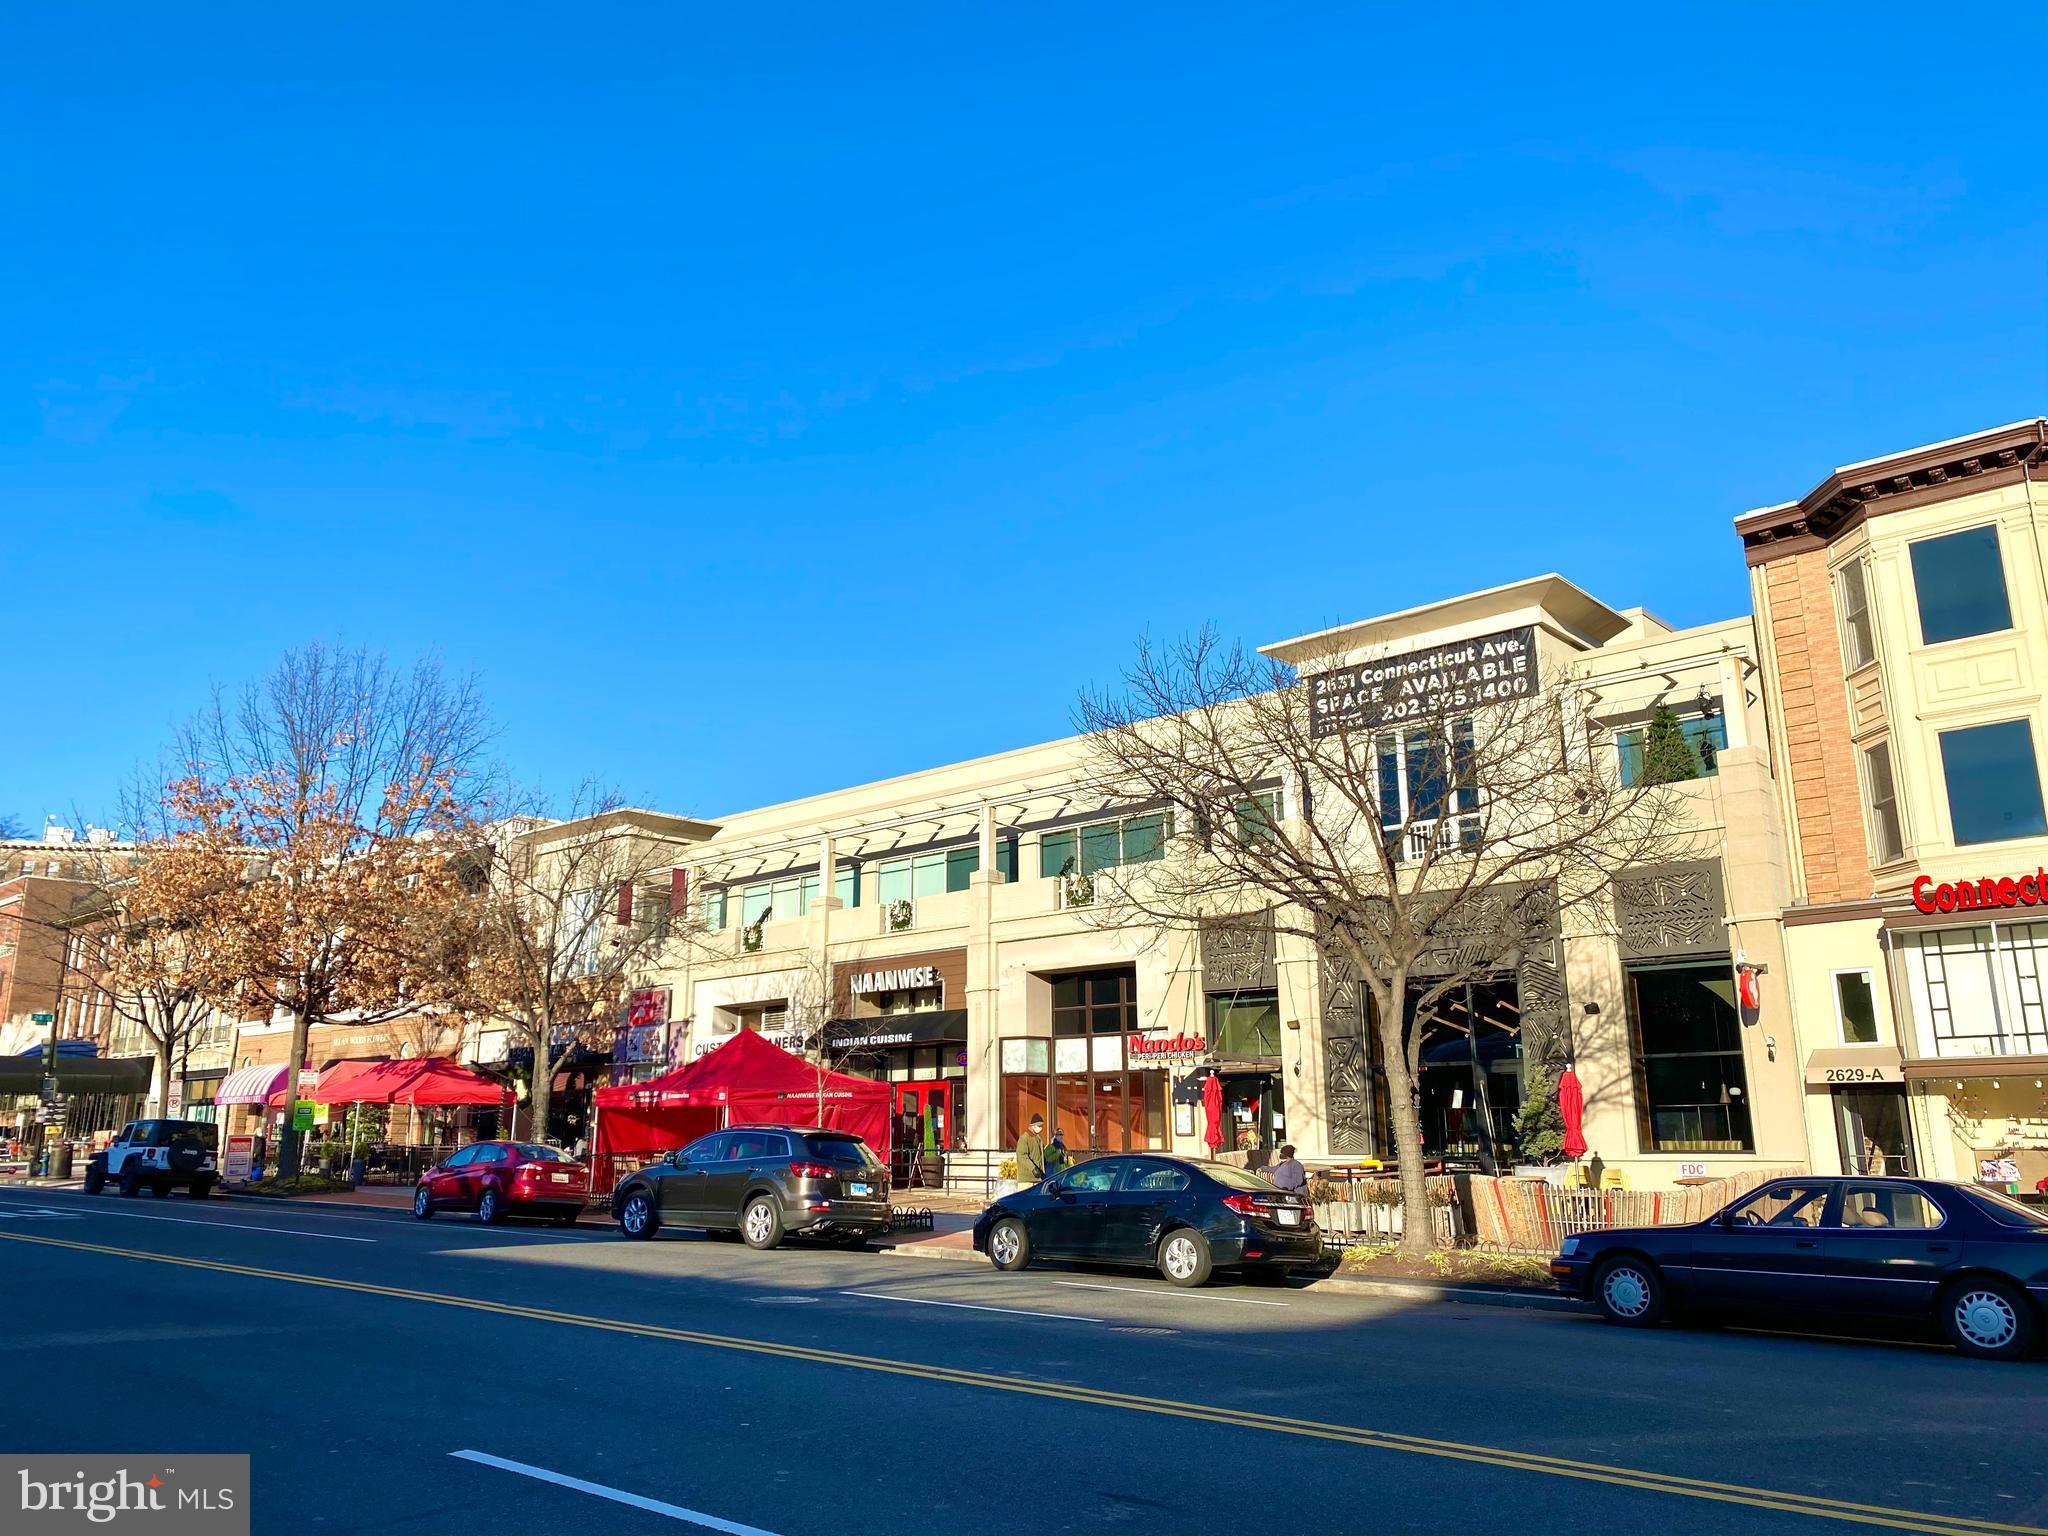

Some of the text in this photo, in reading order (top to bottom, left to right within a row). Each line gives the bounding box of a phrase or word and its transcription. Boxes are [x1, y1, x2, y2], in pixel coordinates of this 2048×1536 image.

[1361, 646, 1475, 685] Connecticut
[1481, 640, 1525, 658] Ave.
[1316, 655, 1526, 714] SPACE AVAILABLE
[850, 966, 934, 994] NAANWISE
[832, 1033, 913, 1047] INDIAN CUISINE
[1129, 1032, 1205, 1053] Nando's
[1168, 1050, 1194, 1059] CHICKEN
[1826, 1068, 1884, 1081] 2629-A
[182, 1147, 198, 1155] Jeep
[1681, 1164, 1704, 1175] FDC
